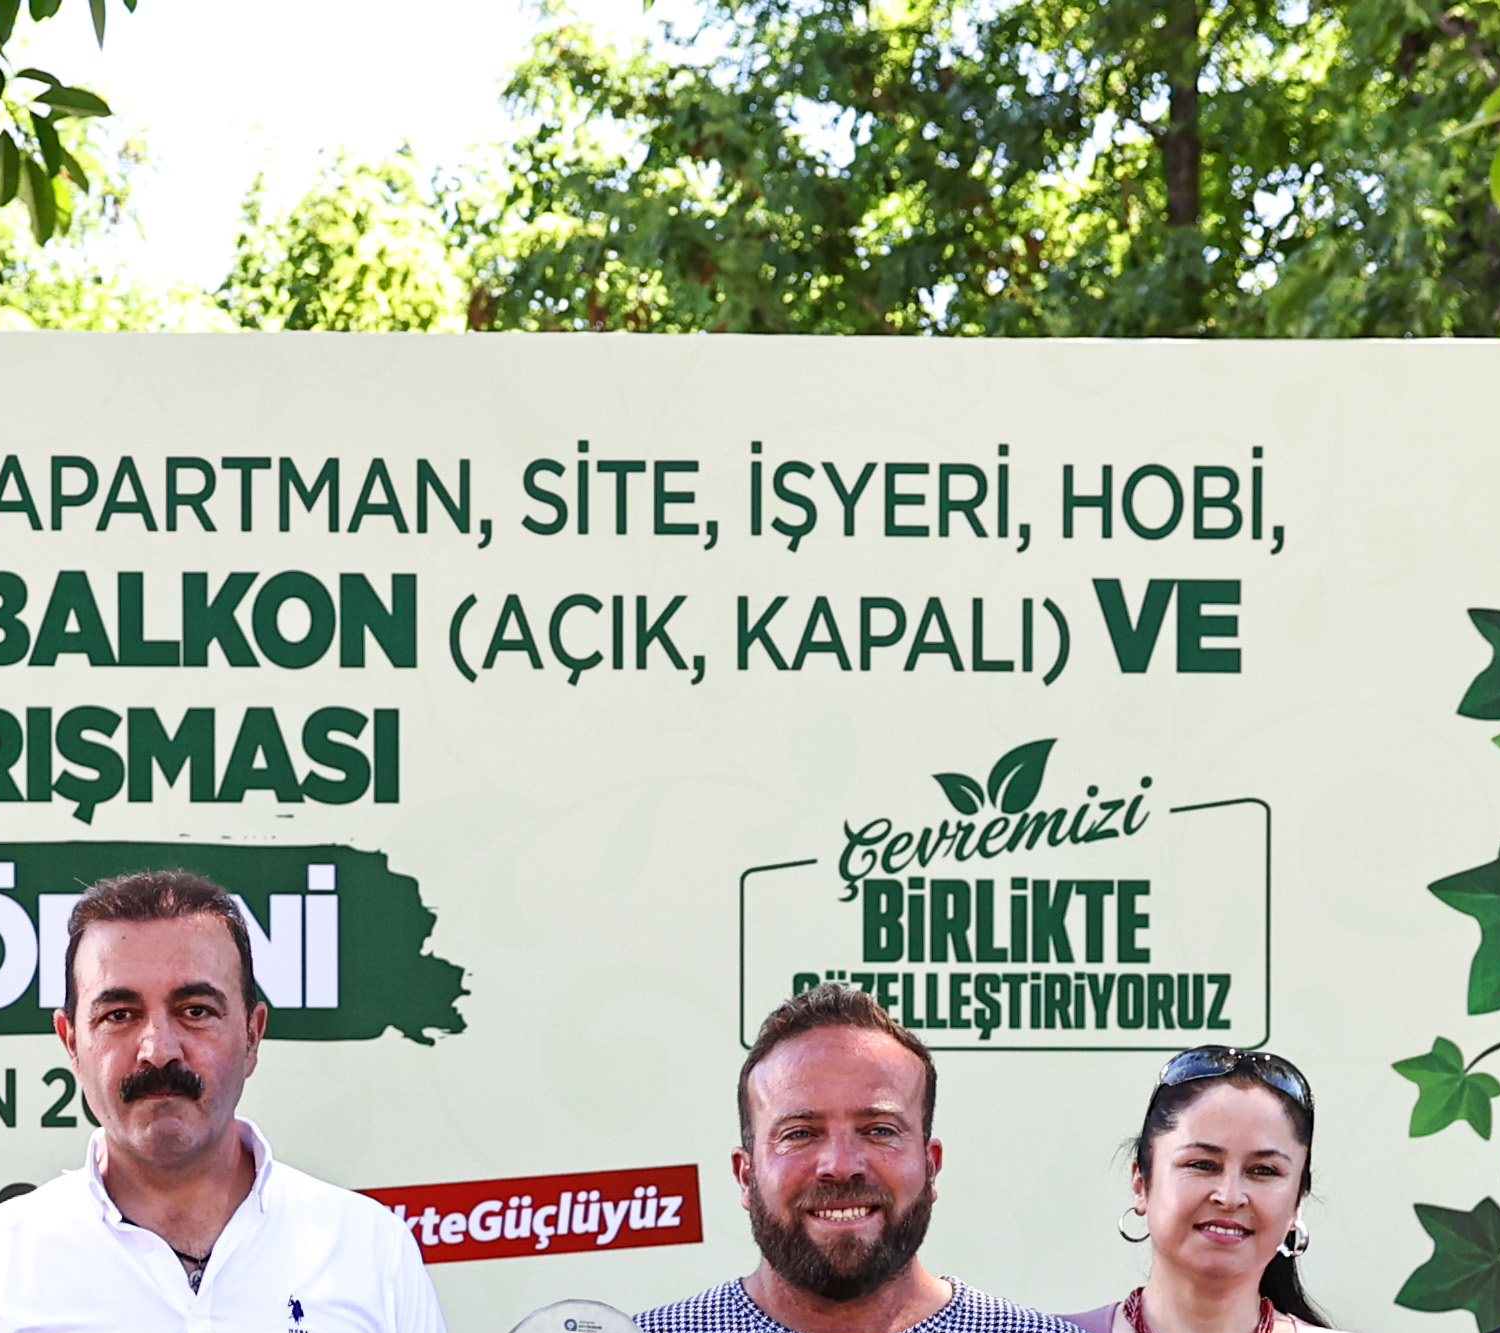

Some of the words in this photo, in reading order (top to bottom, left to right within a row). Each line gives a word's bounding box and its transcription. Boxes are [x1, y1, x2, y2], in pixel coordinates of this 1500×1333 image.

[522, 440, 718, 550] SİTE,
[751, 441, 1030, 553] İŞYERİ,
[1063, 446, 1284, 555] HOBİ,
[449, 594, 705, 686] (AÇIK,
[737, 596, 1070, 686] KAPALI)
[1092, 578, 1241, 673] VE
[837, 776, 1156, 898] Çevremizi
